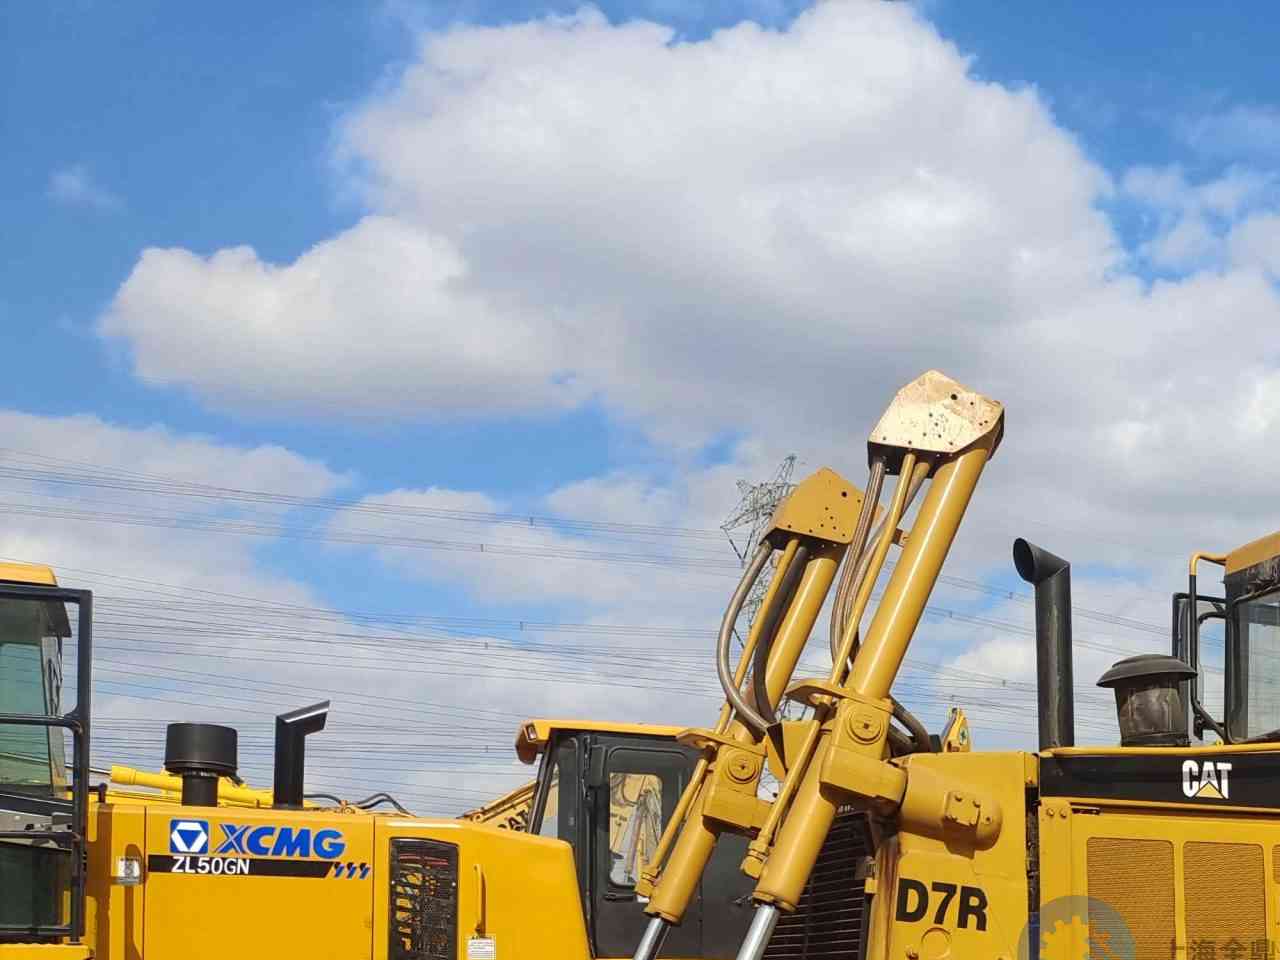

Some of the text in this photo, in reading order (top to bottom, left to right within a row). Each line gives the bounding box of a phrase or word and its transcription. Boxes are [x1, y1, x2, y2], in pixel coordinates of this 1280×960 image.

[1182, 760, 1232, 799] CAT
[214, 824, 346, 859] XCMG
[171, 856, 250, 875] ZL50GN
[895, 878, 988, 932] D7R
